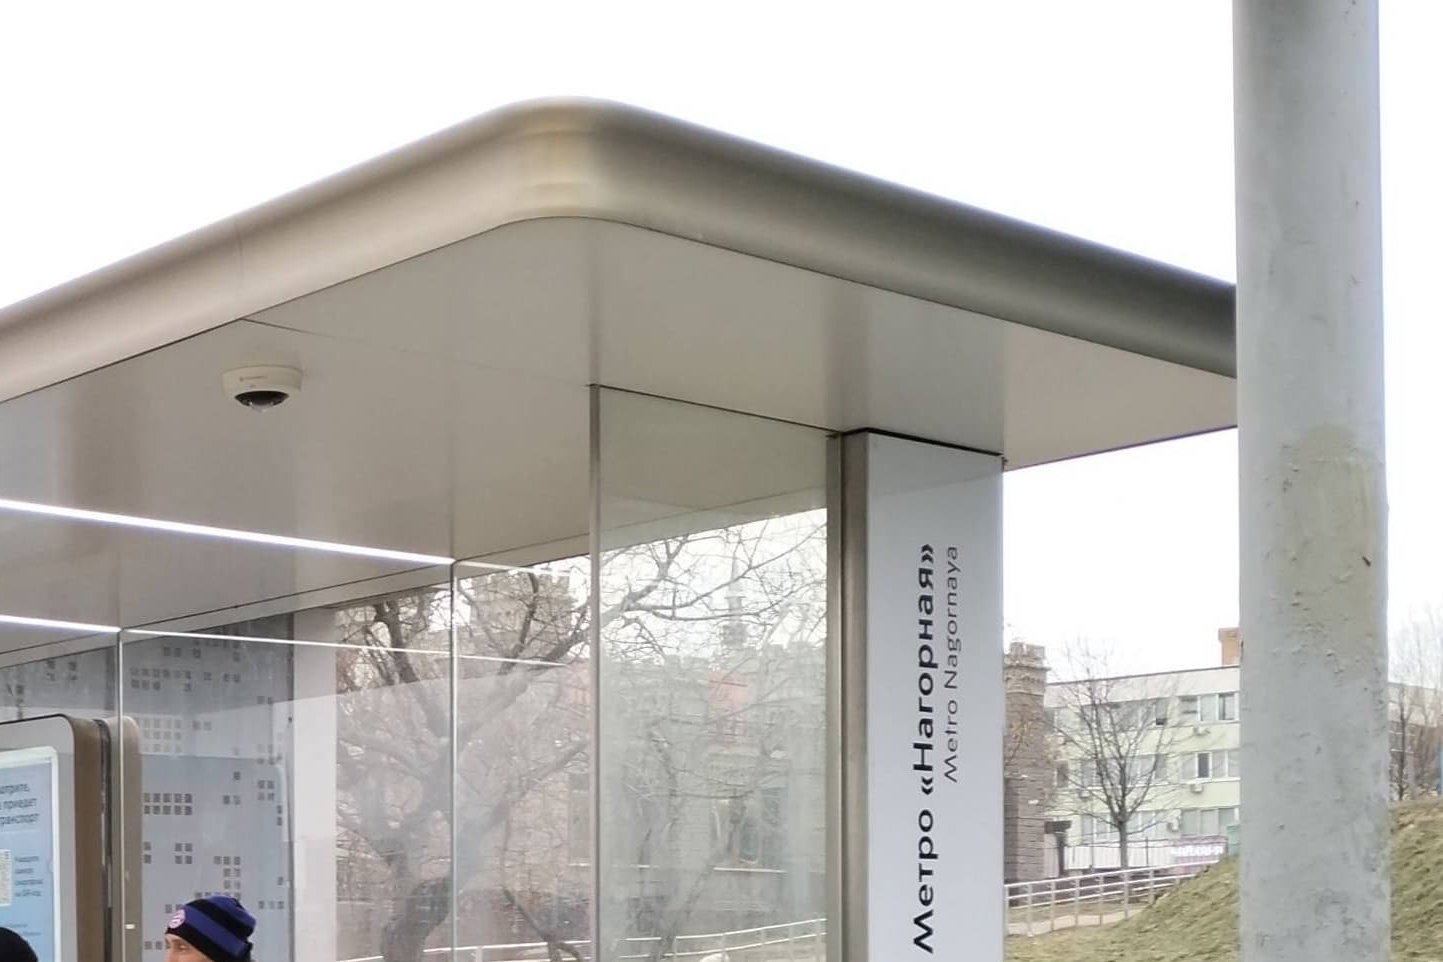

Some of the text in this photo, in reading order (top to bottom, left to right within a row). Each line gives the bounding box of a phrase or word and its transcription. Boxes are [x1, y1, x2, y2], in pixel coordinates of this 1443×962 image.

[912, 543, 939, 954] Метро «Нагорная»
[943, 546, 961, 783] Metro Nagornaya
